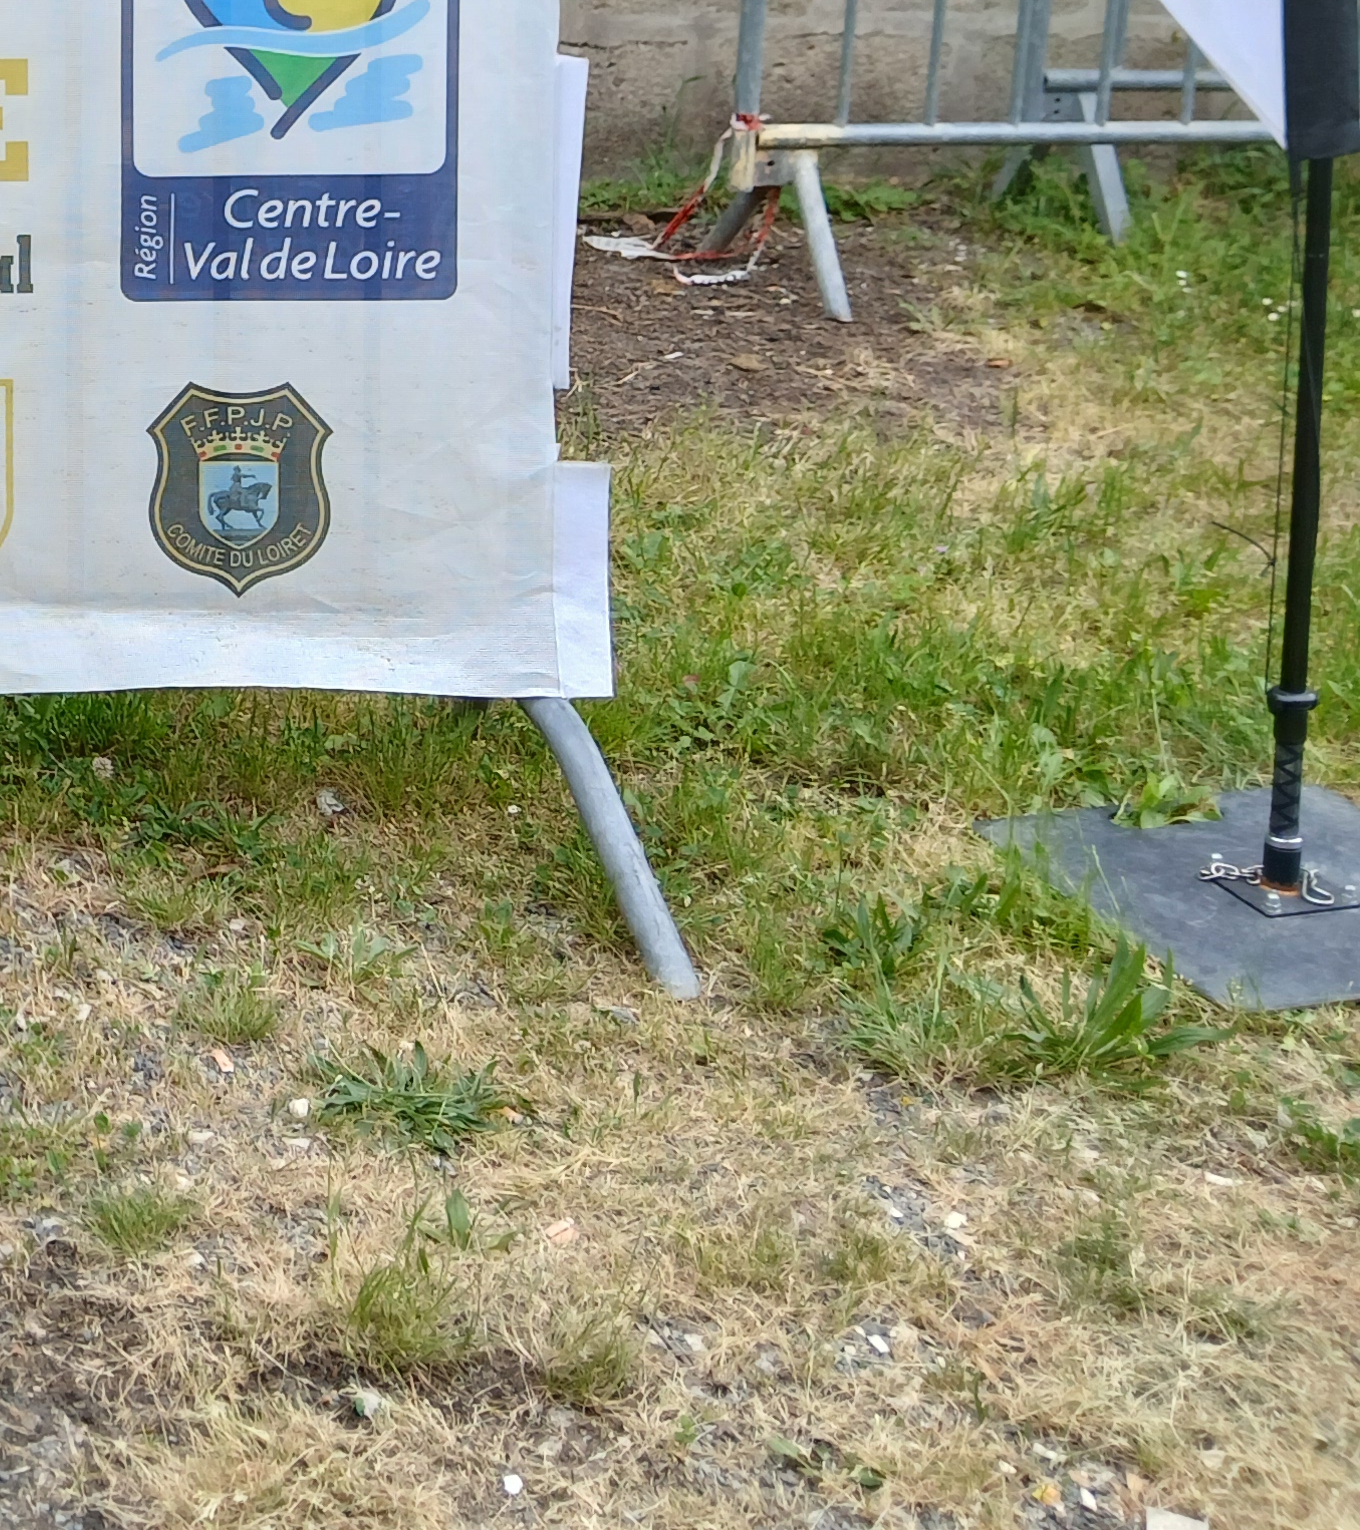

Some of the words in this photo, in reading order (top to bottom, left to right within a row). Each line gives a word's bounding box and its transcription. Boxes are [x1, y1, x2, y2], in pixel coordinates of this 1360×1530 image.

[224, 188, 401, 229] Centre-
[134, 194, 164, 280] Région
[230, 550, 254, 567] DU
[257, 521, 312, 566] LOIRET
